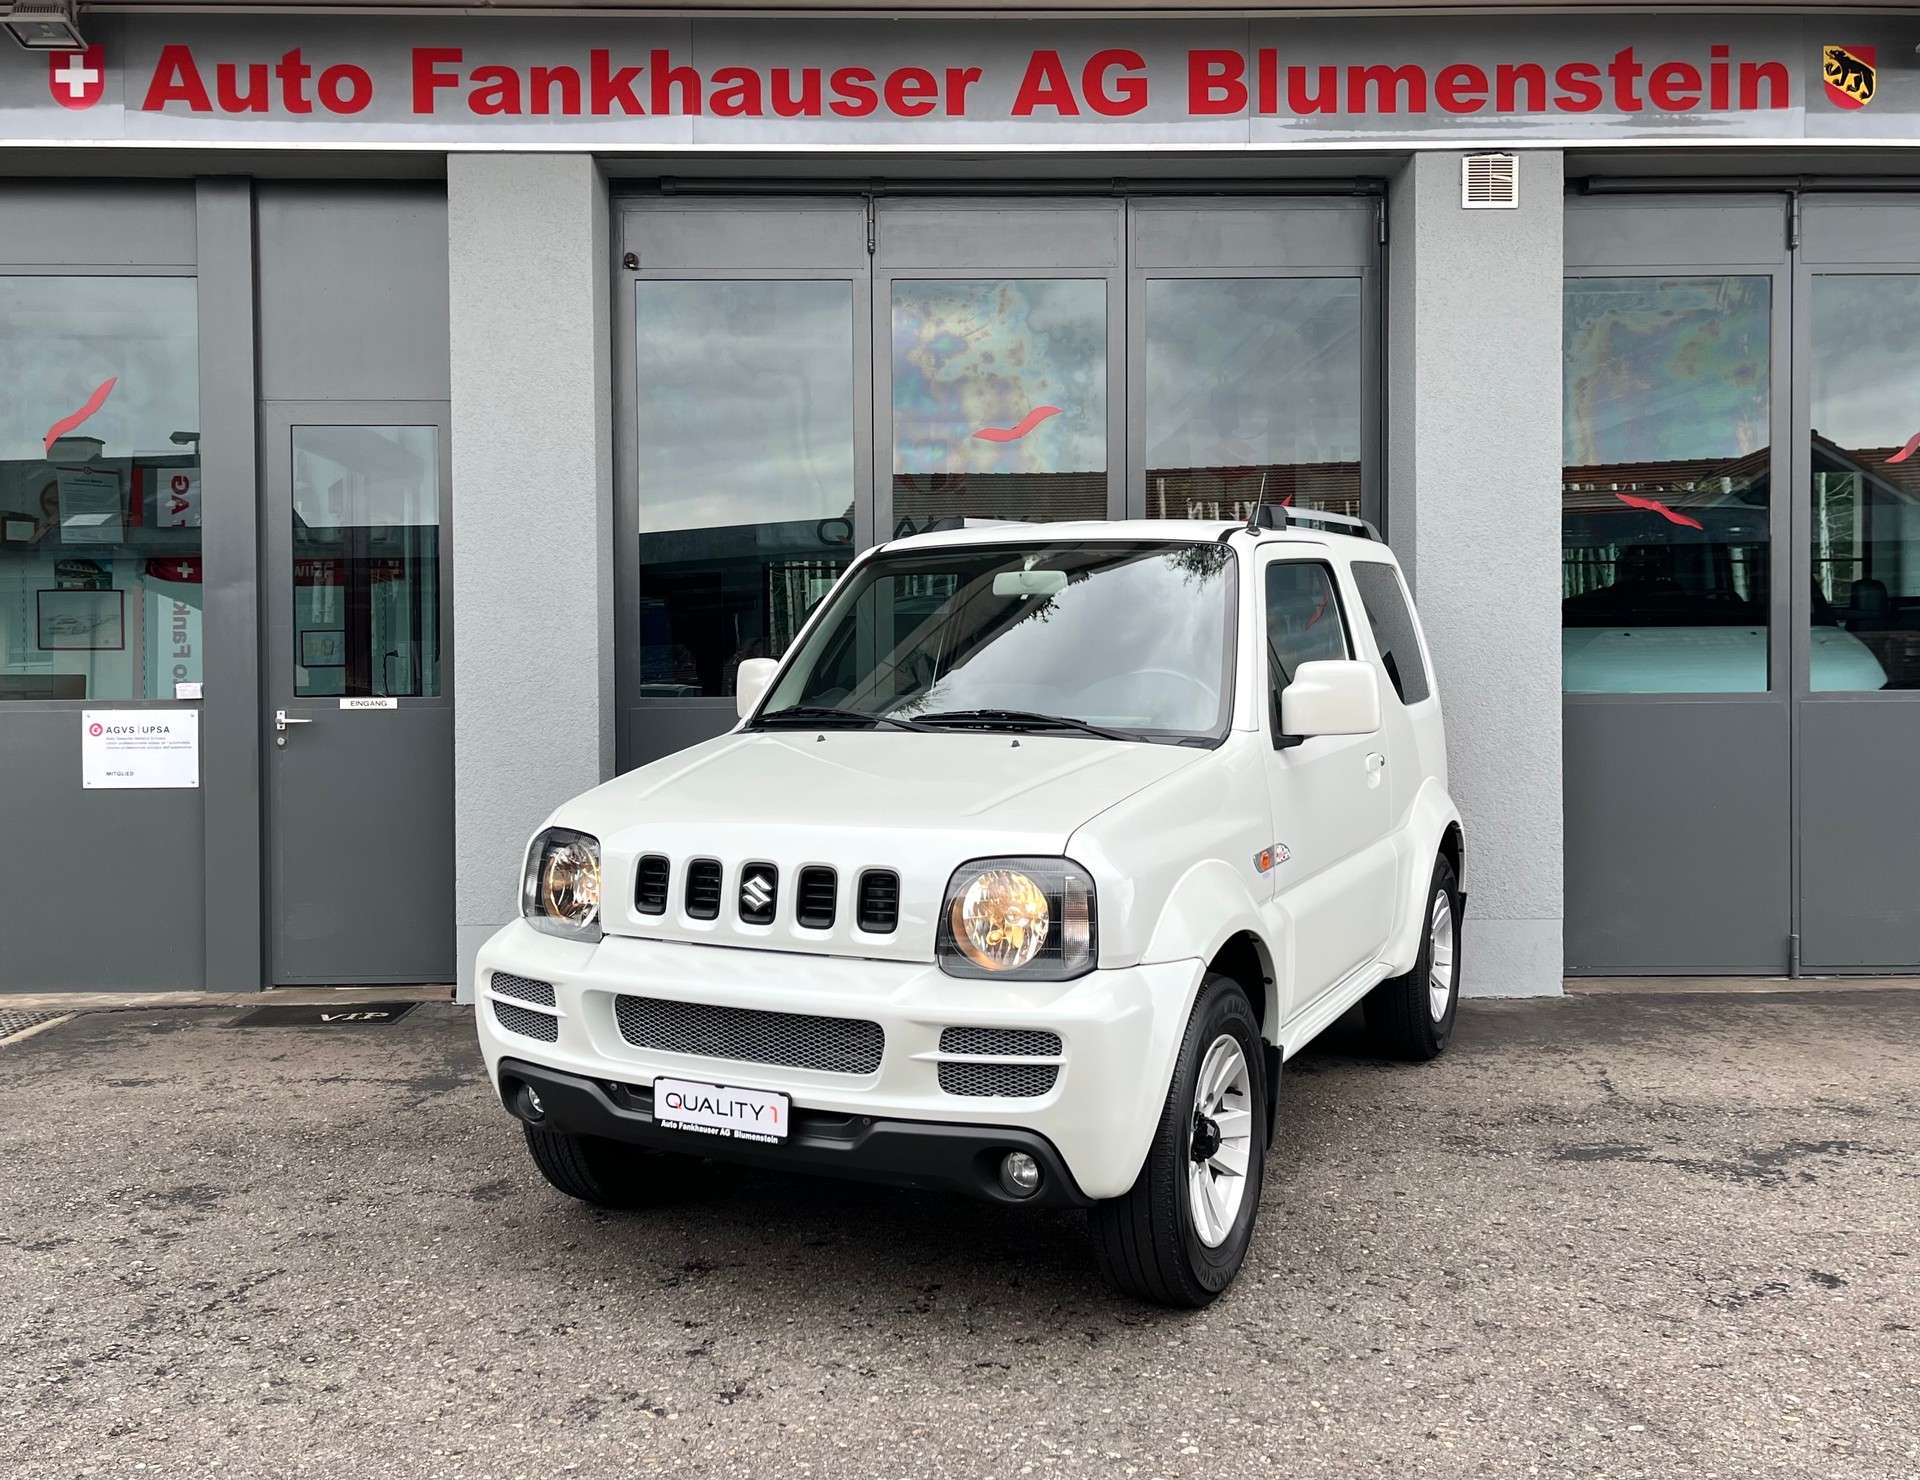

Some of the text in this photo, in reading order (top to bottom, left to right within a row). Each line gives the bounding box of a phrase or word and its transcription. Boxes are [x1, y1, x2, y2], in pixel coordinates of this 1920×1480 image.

[142, 45, 1790, 118] Auto Fankhauser AG Blumenstein
[106, 726, 170, 734] AGVS UPSA
[320, 1012, 390, 1022] VIP
[665, 1093, 764, 1120] QUALITY
[661, 1119, 778, 1144] Auto Fankhauser AG Blumenstein
